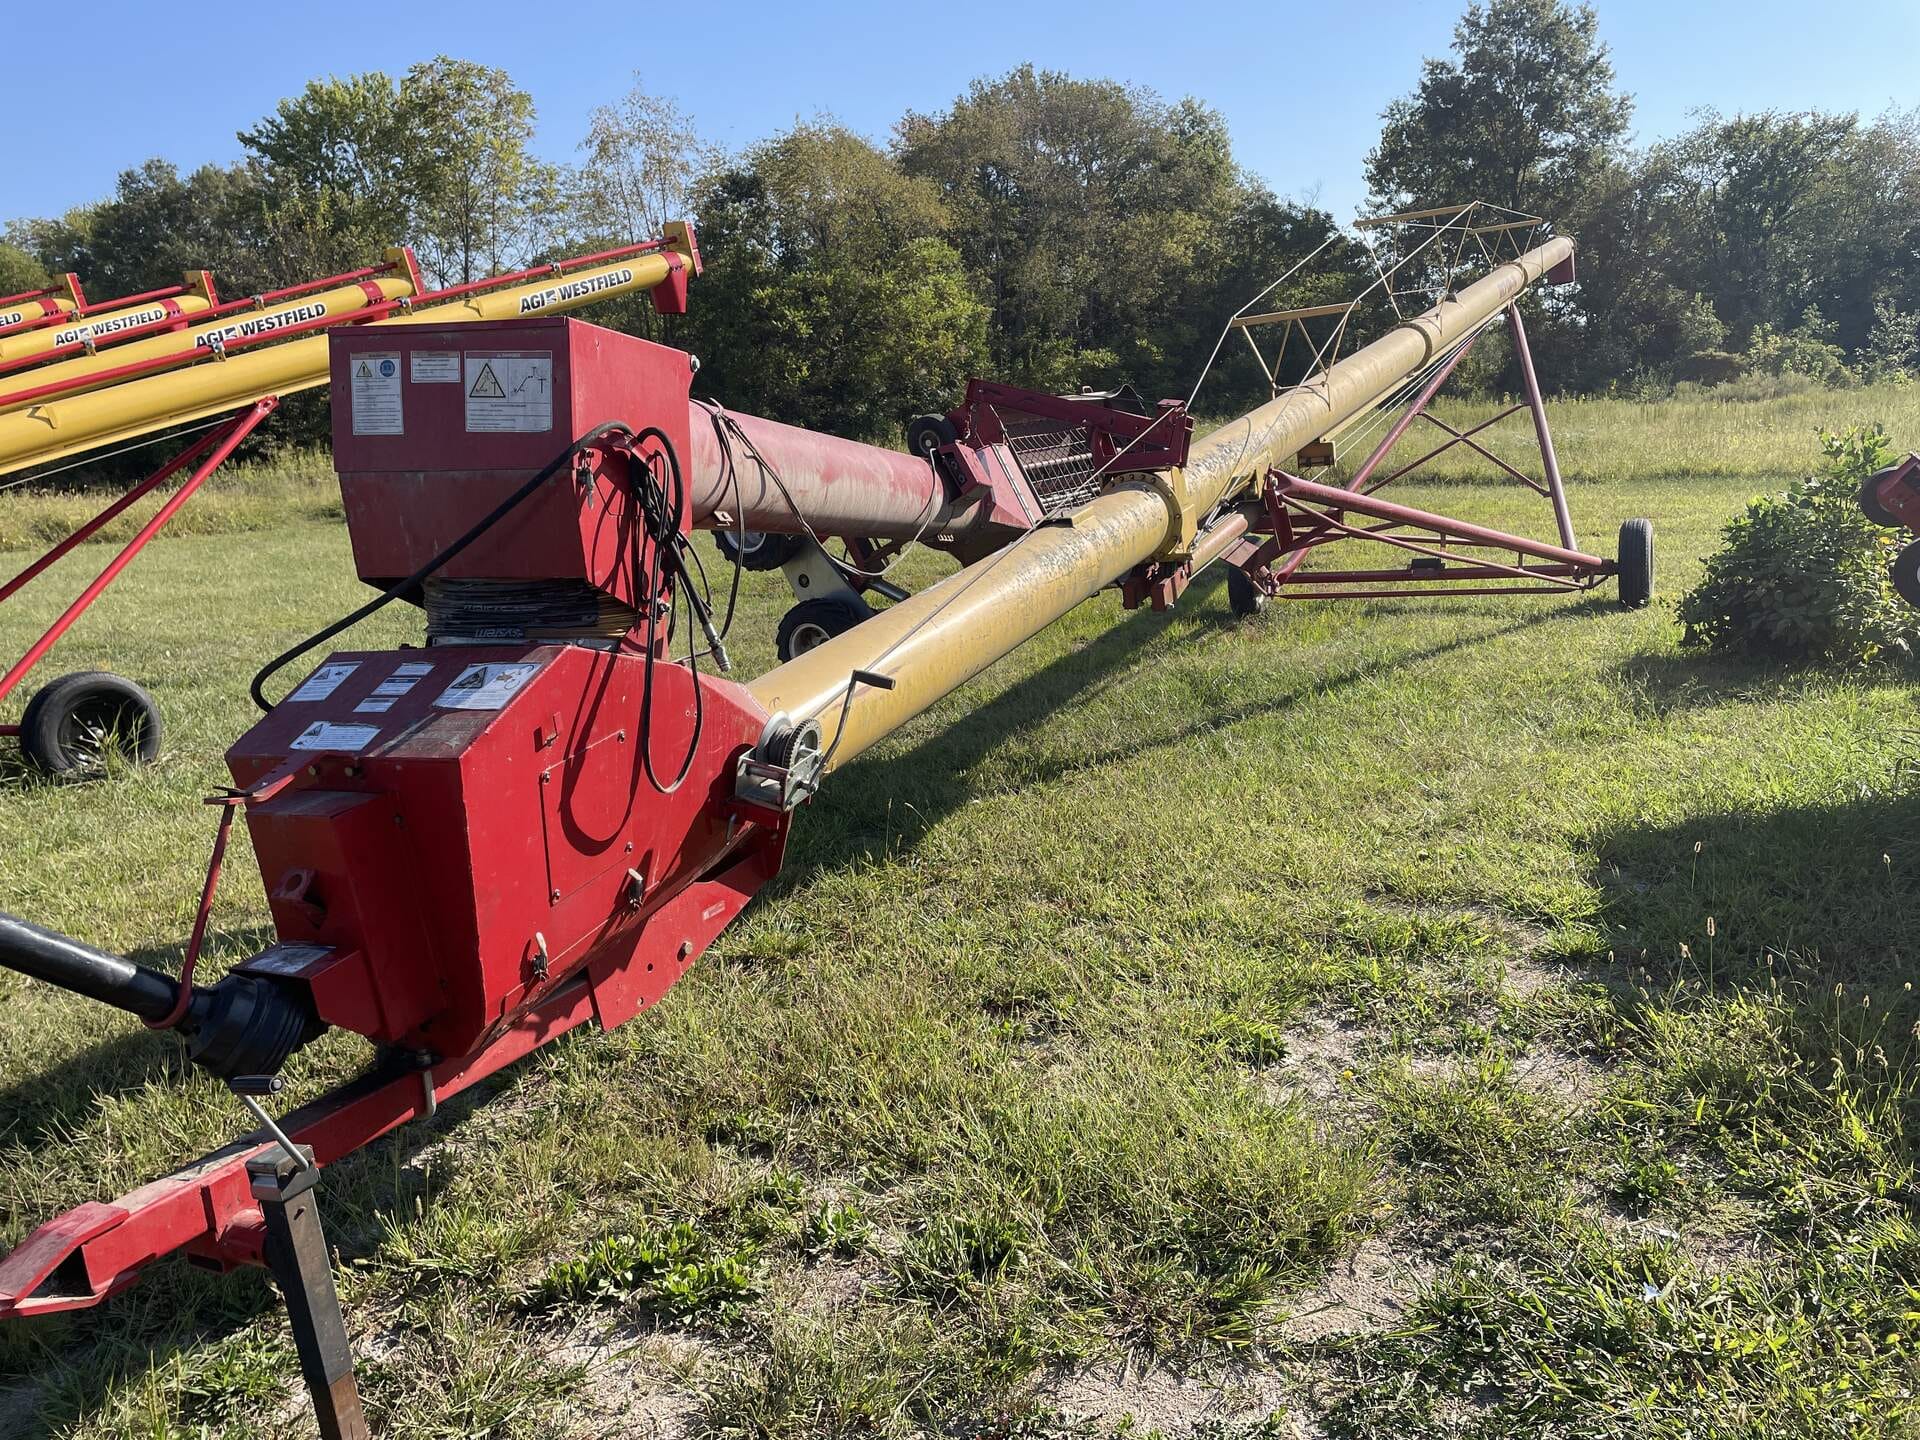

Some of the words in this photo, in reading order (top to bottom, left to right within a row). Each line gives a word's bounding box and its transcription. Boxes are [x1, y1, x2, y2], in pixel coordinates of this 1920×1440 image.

[520, 293, 546, 313] AGI
[558, 269, 633, 301] WESTFIELD
[56, 330, 79, 346] AGI
[92, 309, 163, 335] WESTFIELD
[196, 330, 224, 347] AGI
[240, 303, 326, 336] WESTFIELD
